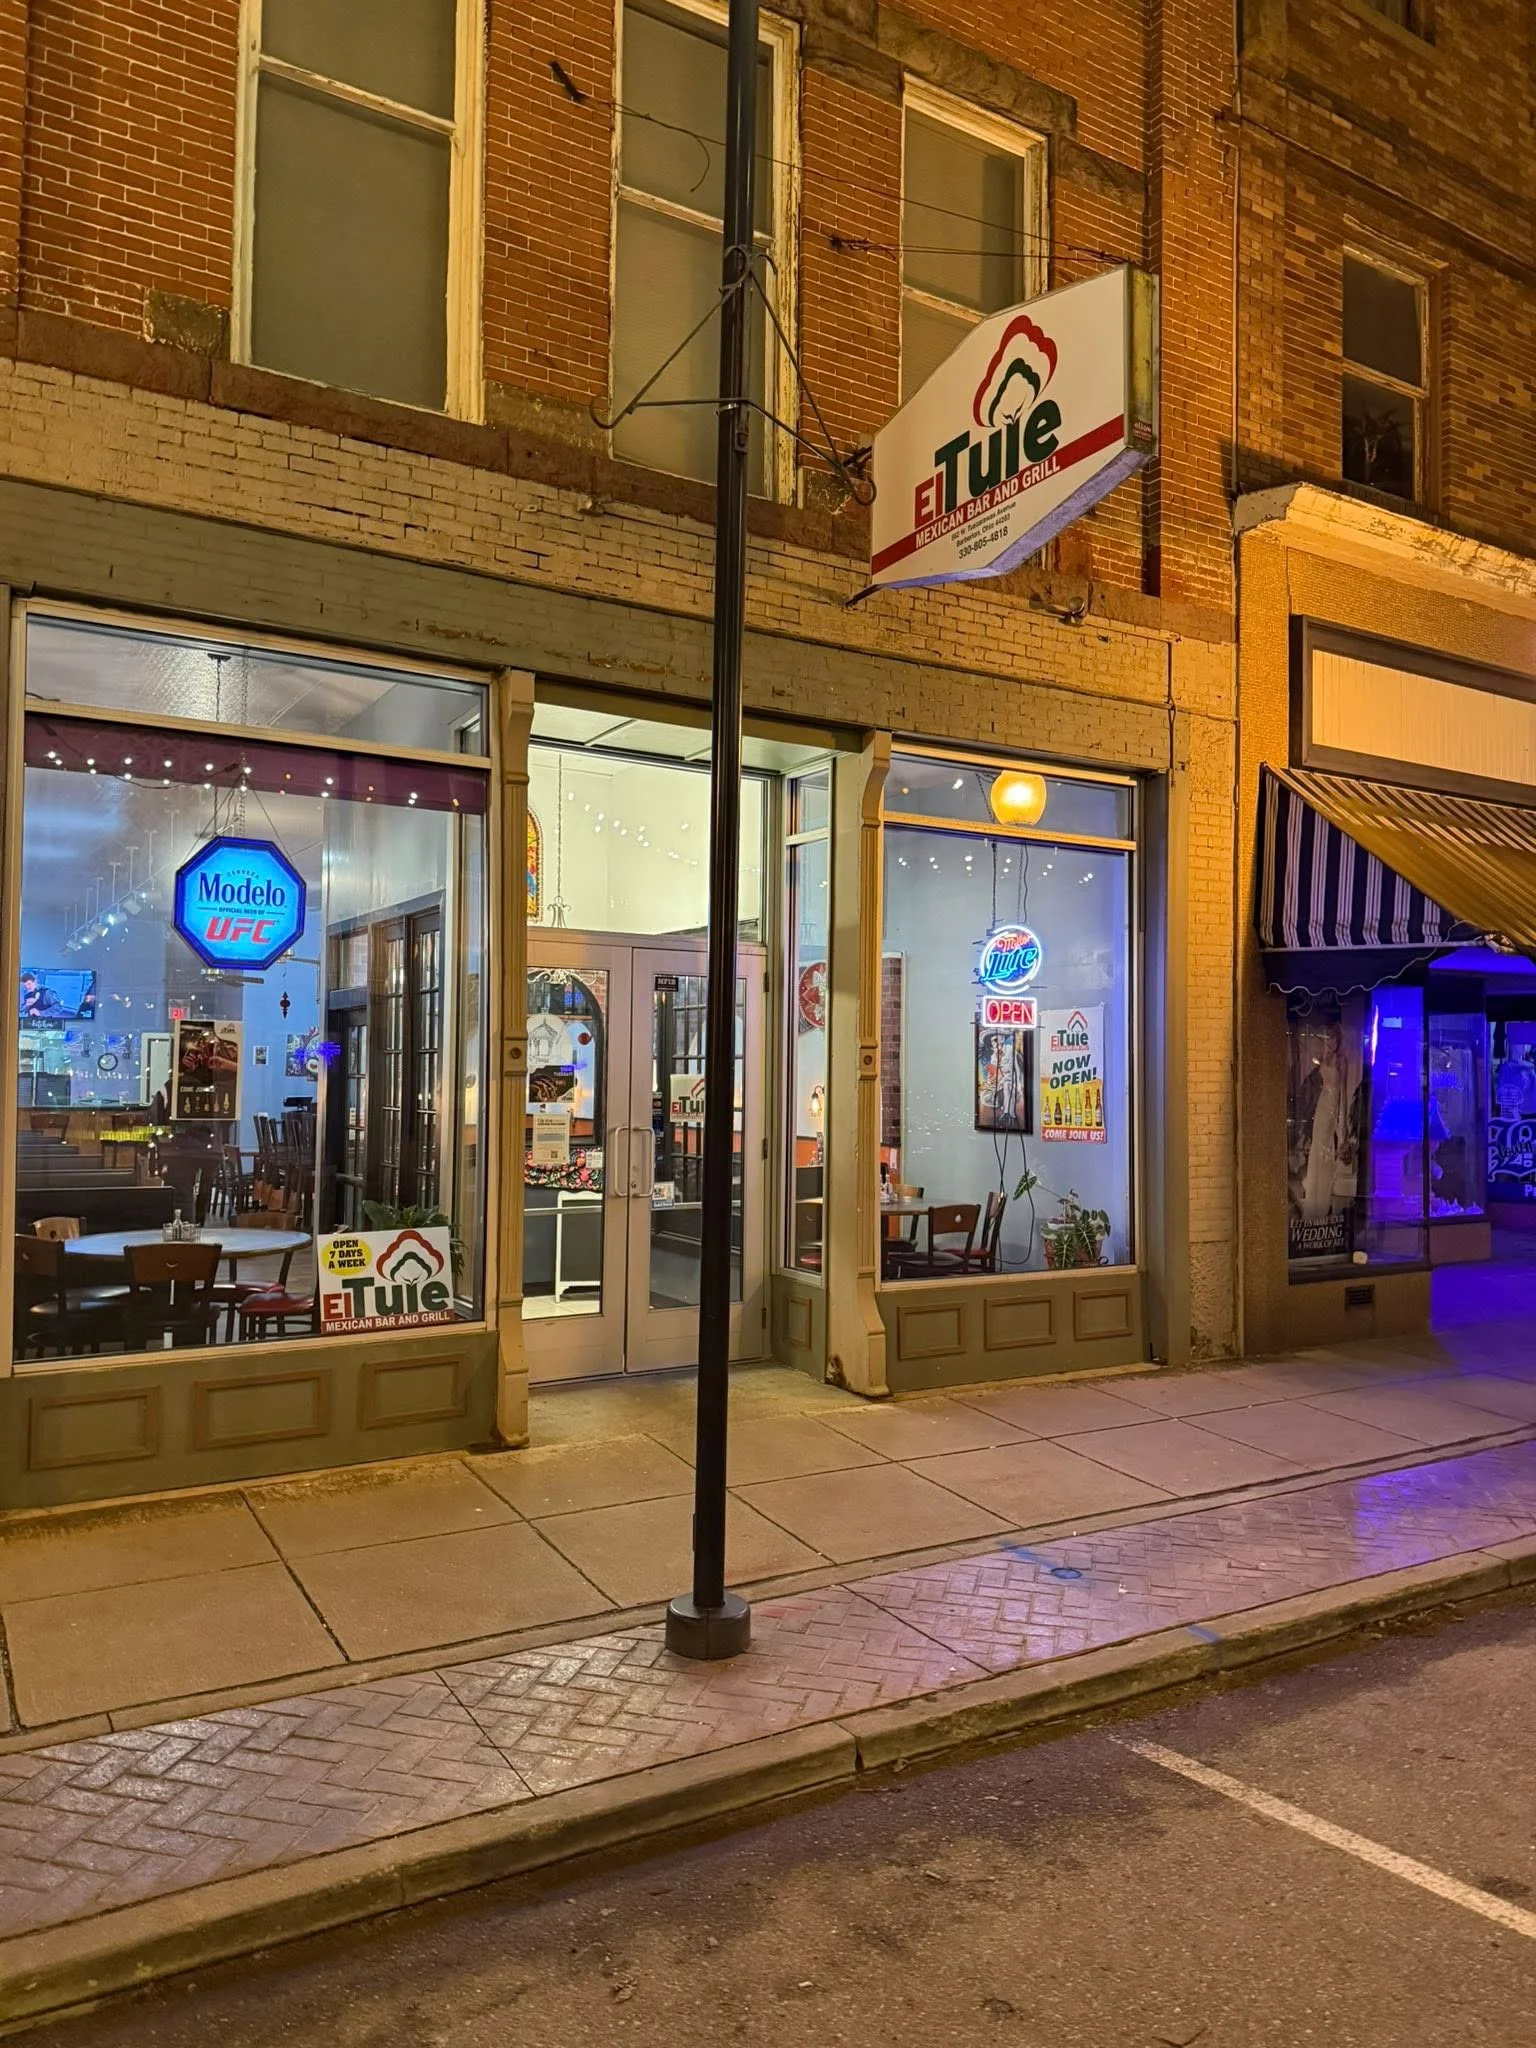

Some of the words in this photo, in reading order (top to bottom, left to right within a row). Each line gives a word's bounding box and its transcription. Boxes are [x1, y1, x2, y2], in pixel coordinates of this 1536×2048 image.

[915, 508, 965, 549] MEXICAN
[967, 492, 991, 520] BAR
[992, 476, 1019, 506] AND
[1022, 455, 1061, 487] GRILL
[996, 501, 1017, 516] Avenue
[982, 522, 994, 533] Ohio
[958, 526, 1009, 560] 330-805-4818
[199, 871, 286, 908] Modelo
[205, 916, 275, 944] UFC
[984, 947, 1038, 982] Lite
[986, 999, 1036, 1025] OPEN
[1052, 1054, 1092, 1075] NOW
[1049, 1067, 1097, 1090] OPEN!
[678, 1096, 705, 1113] Tul
[1044, 1128, 1067, 1139] COME
[1068, 1129, 1088, 1140] JOIN
[1090, 1129, 1104, 1141] US!
[1291, 1224, 1343, 1242] WEDDING
[329, 1250, 336, 1260] 7
[338, 1248, 363, 1259] DAYS
[332, 1239, 359, 1249] OPEN
[328, 1260, 335, 1269] A
[338, 1258, 366, 1268] WEEK
[326, 1319, 373, 1332] MEXICAN
[375, 1316, 396, 1328] BAR
[398, 1314, 419, 1325] AND
[421, 1311, 451, 1322] GRILL
